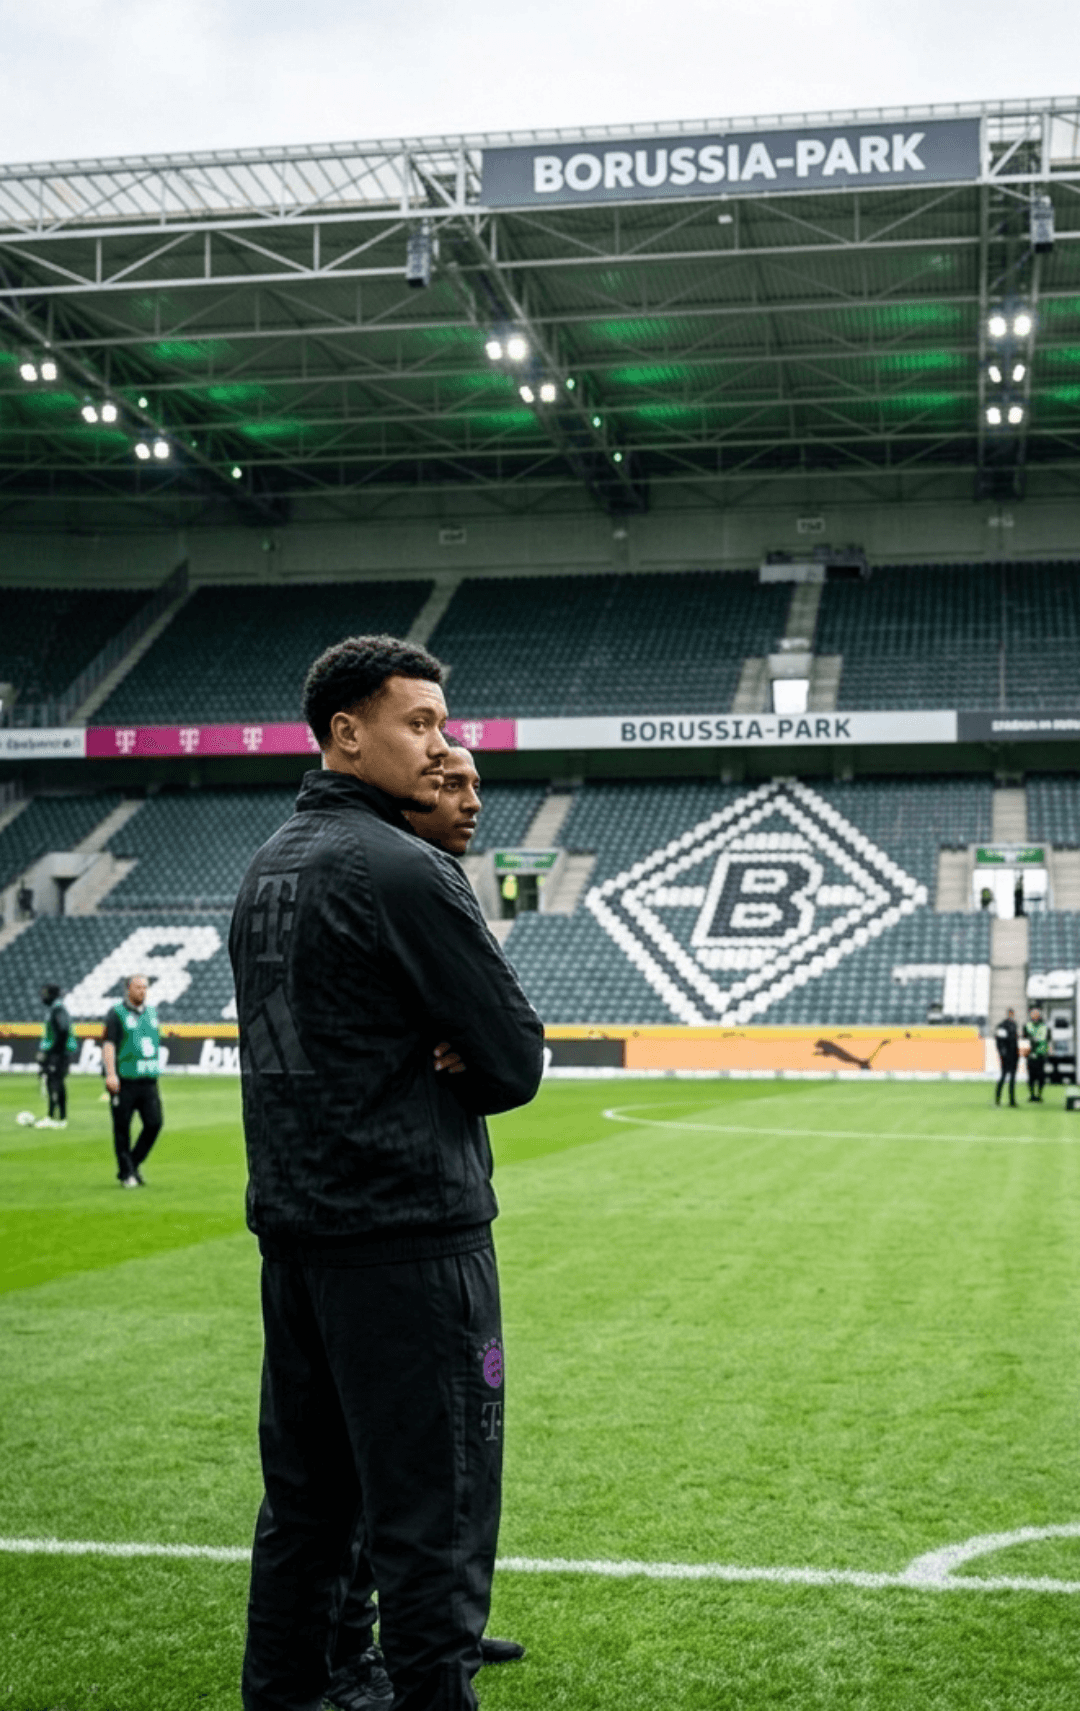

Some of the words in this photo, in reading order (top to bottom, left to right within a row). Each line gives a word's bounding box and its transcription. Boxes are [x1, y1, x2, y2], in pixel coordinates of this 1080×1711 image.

[533, 133, 926, 193] BORUSSIA-PARK
[620, 718, 852, 742] BORUSSIA-PARK
[251, 872, 299, 962] T
[697, 855, 821, 944] B
